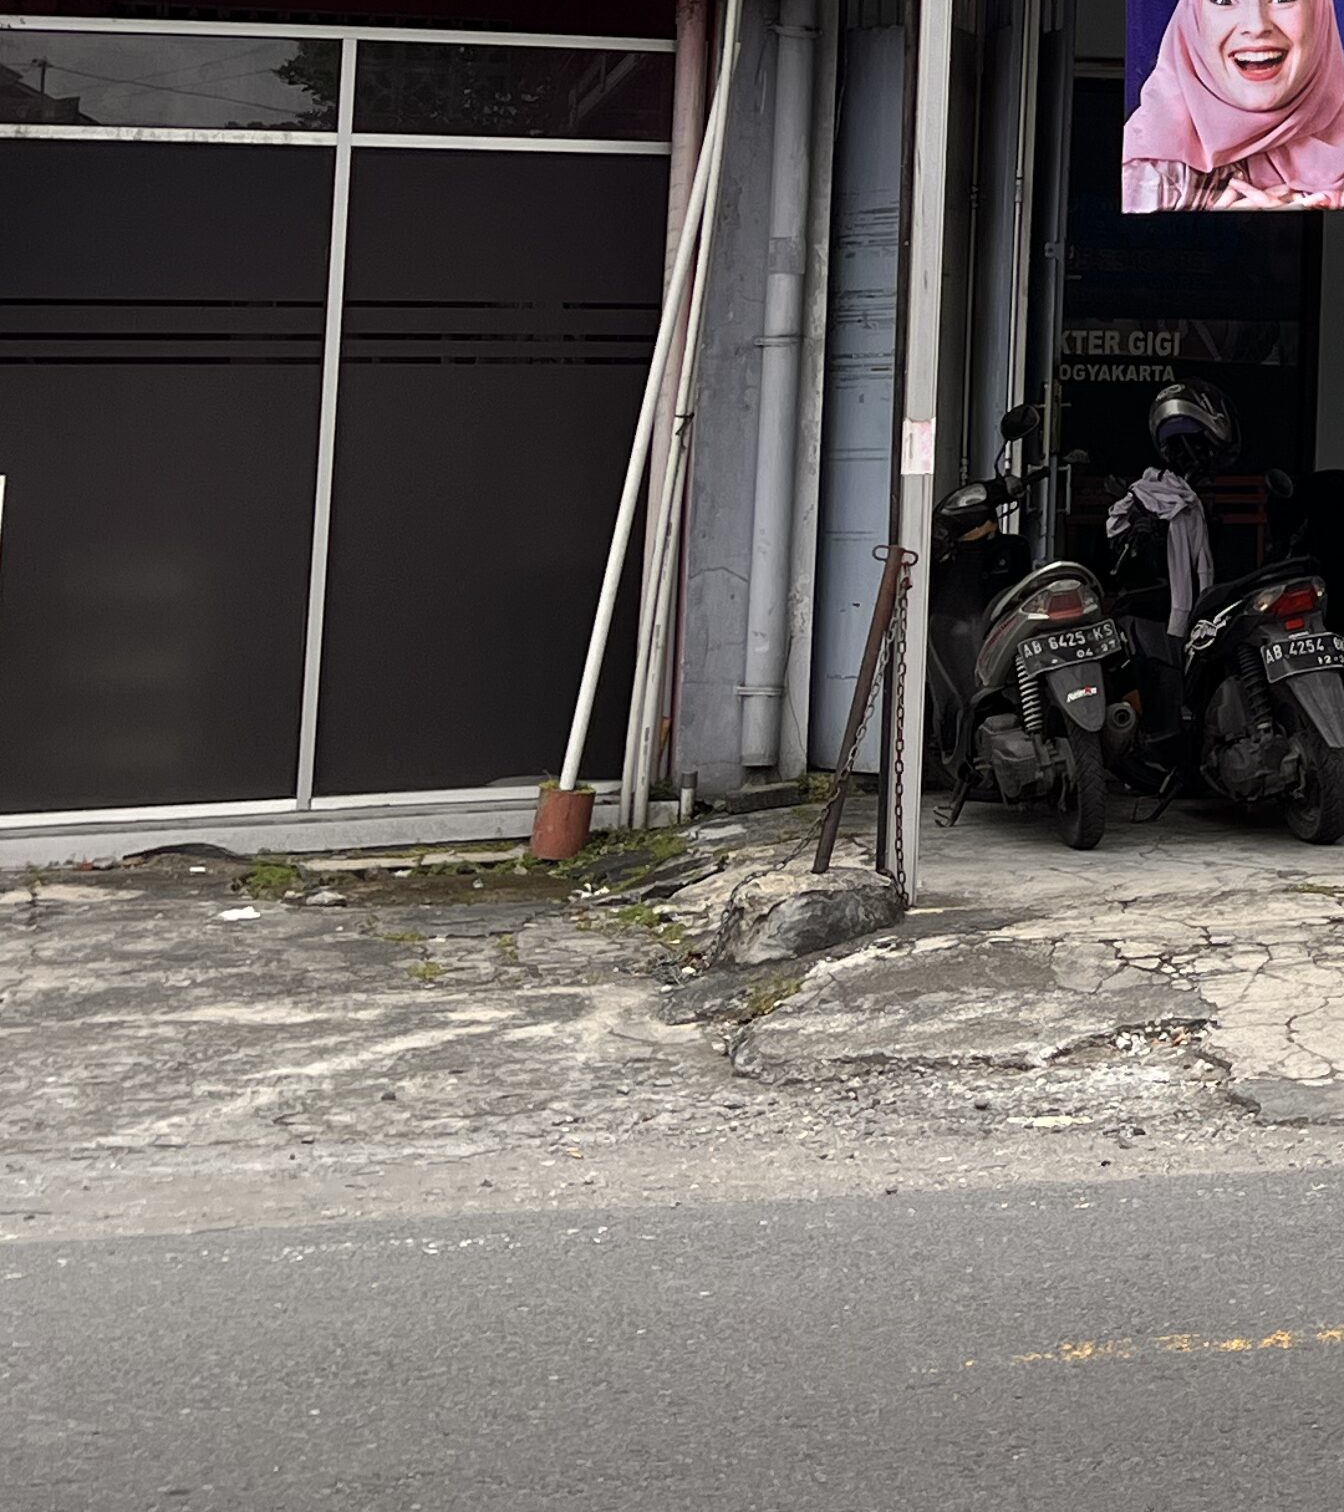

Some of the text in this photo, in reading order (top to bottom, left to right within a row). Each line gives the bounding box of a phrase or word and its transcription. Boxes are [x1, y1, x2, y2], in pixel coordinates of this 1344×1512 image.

[1128, 331, 1181, 356] GIGI
[1059, 364, 1176, 382] OGYAKARTA
[1023, 623, 1113, 658] AB 6425 KS
[1266, 644, 1282, 663] AB
[1289, 638, 1324, 655] 4254
